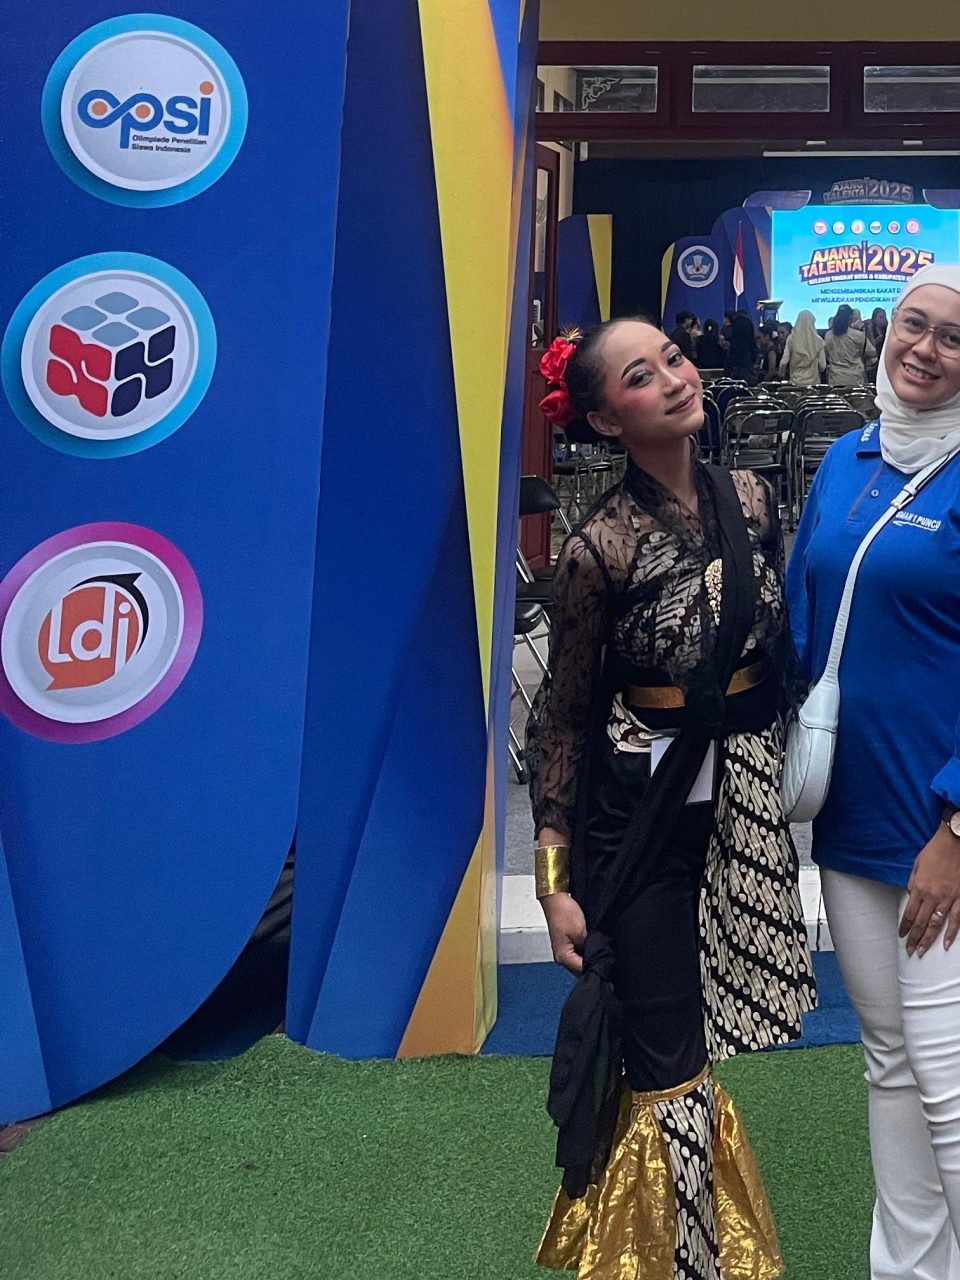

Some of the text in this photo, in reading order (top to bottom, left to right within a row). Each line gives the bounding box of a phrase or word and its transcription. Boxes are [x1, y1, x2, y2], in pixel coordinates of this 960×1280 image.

[131, 143, 191, 153] Siswa Indonesia
[132, 134, 207, 144] Olimpiade Penelitian
[868, 181, 911, 200] 2025
[812, 245, 860, 264] AJANG
[801, 258, 863, 278] TALENTA
